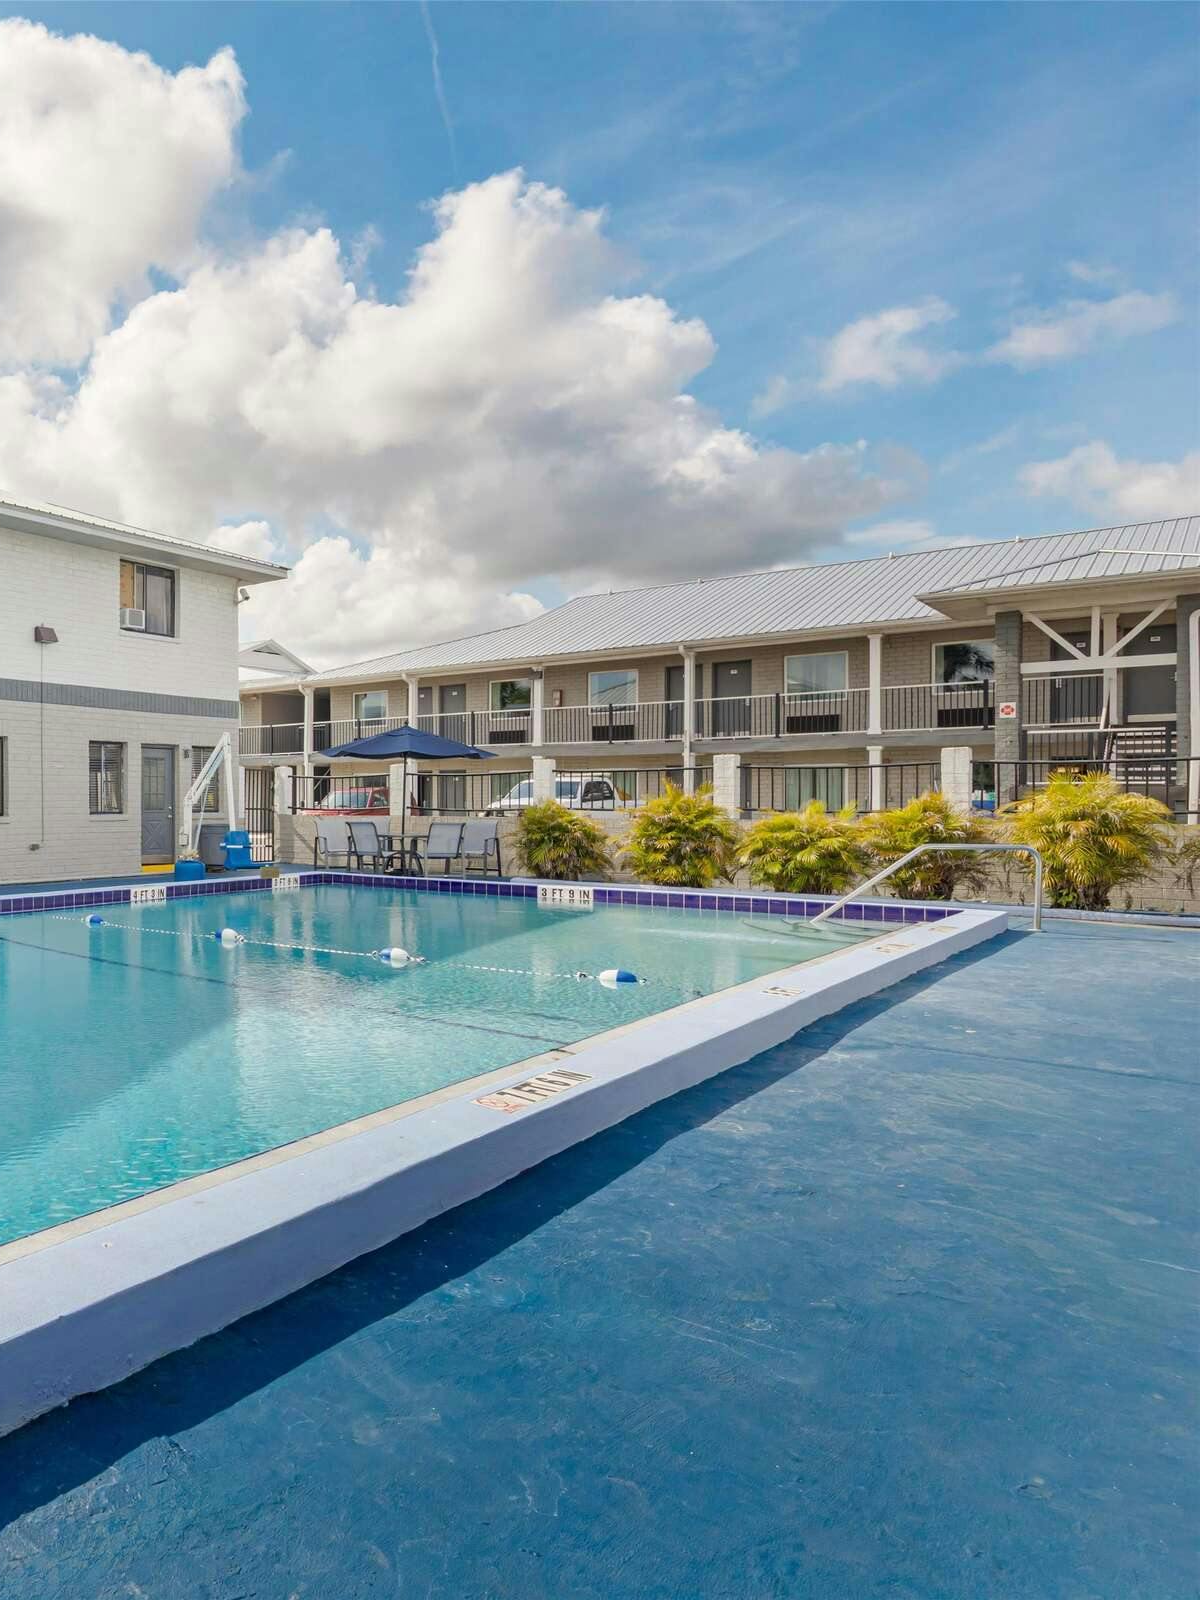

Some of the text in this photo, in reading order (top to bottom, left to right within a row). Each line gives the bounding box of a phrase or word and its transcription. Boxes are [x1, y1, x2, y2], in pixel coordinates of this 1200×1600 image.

[133, 890, 138, 899] 4
[541, 887, 548, 897] 3
[568, 889, 575, 899] 9
